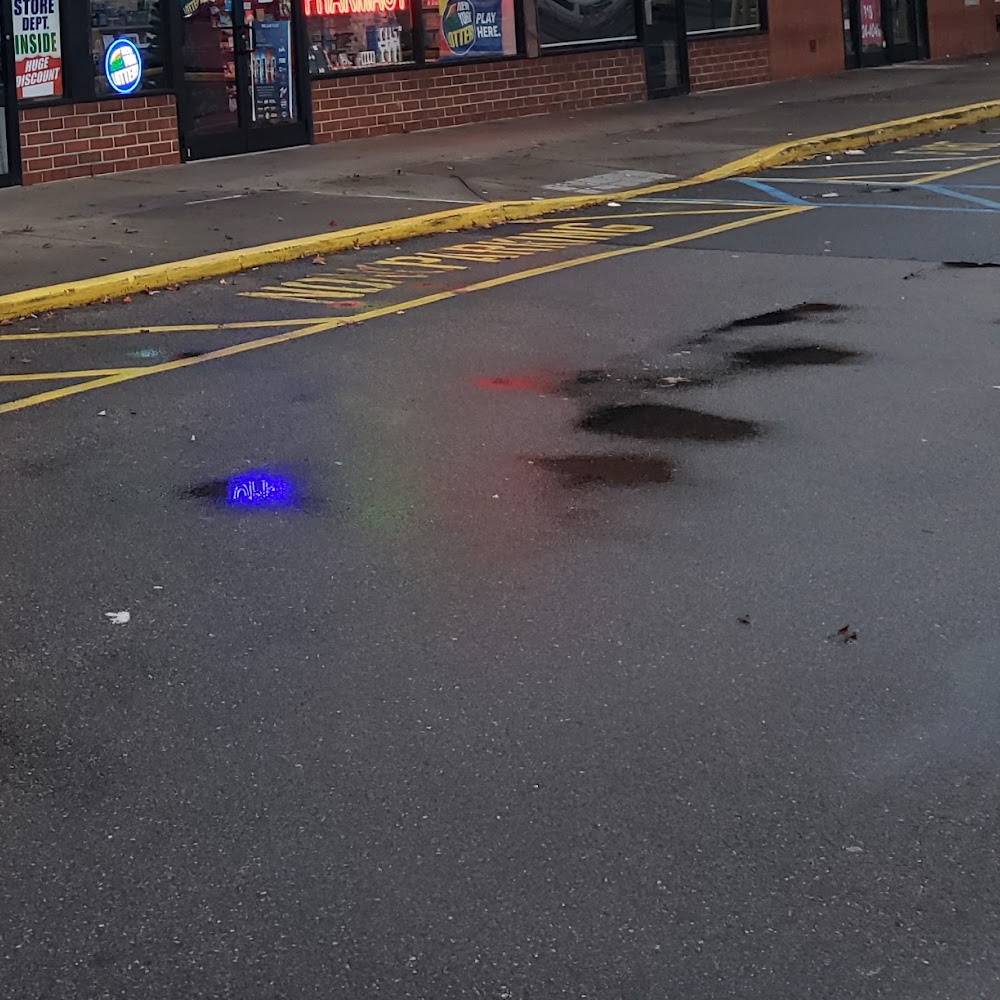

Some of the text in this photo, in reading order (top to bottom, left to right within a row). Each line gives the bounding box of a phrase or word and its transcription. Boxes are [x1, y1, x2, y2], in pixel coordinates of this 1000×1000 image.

[22, 16, 49, 31] DEPT.
[476, 11, 496, 24] PLAY
[477, 26, 501, 38] HERE.
[15, 32, 57, 55] INSIDE
[25, 56, 49, 73] HUGE
[16, 67, 60, 88] DISCOUNT
